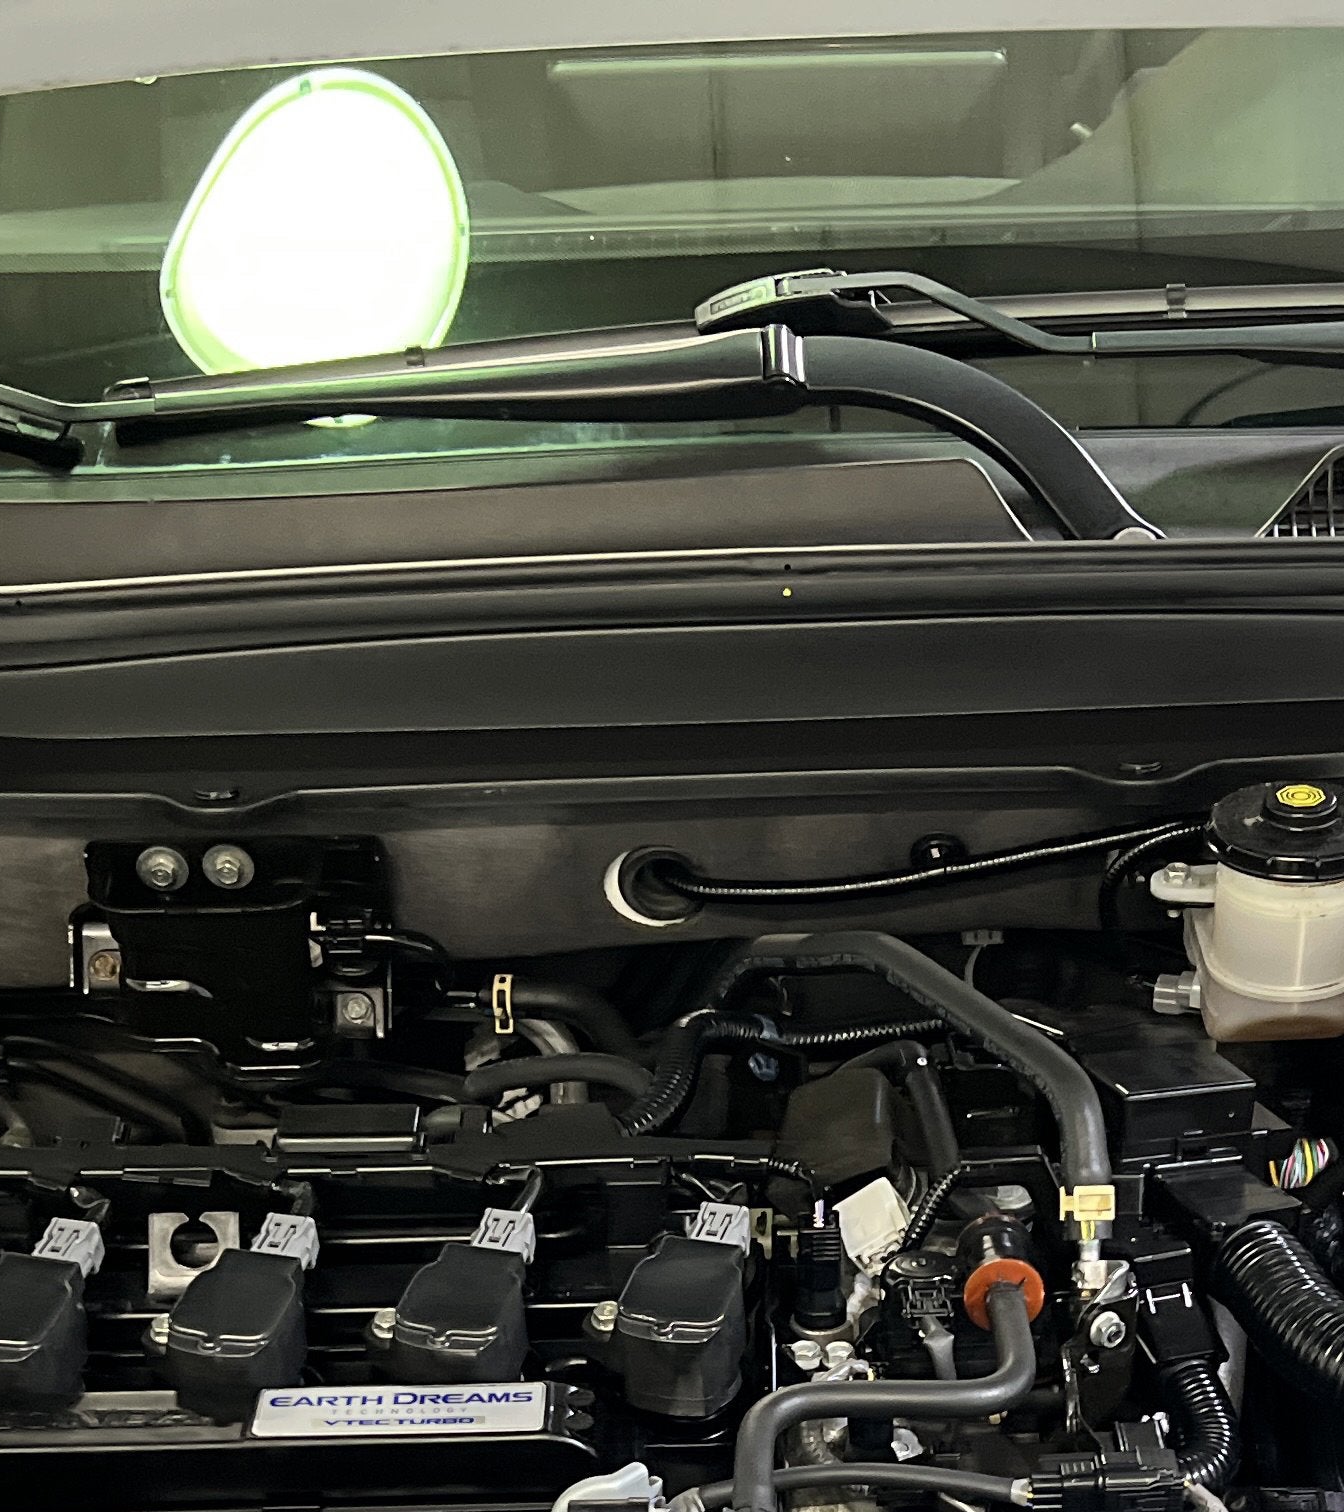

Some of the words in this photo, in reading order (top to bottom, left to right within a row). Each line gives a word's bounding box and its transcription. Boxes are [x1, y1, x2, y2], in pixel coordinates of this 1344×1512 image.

[269, 1395, 383, 1407] EARTH
[393, 1392, 533, 1405] DREAMS
[331, 1407, 469, 1416] TECHNOLOGY
[323, 1418, 391, 1426] VTEC
[398, 1417, 475, 1425] TURBO
